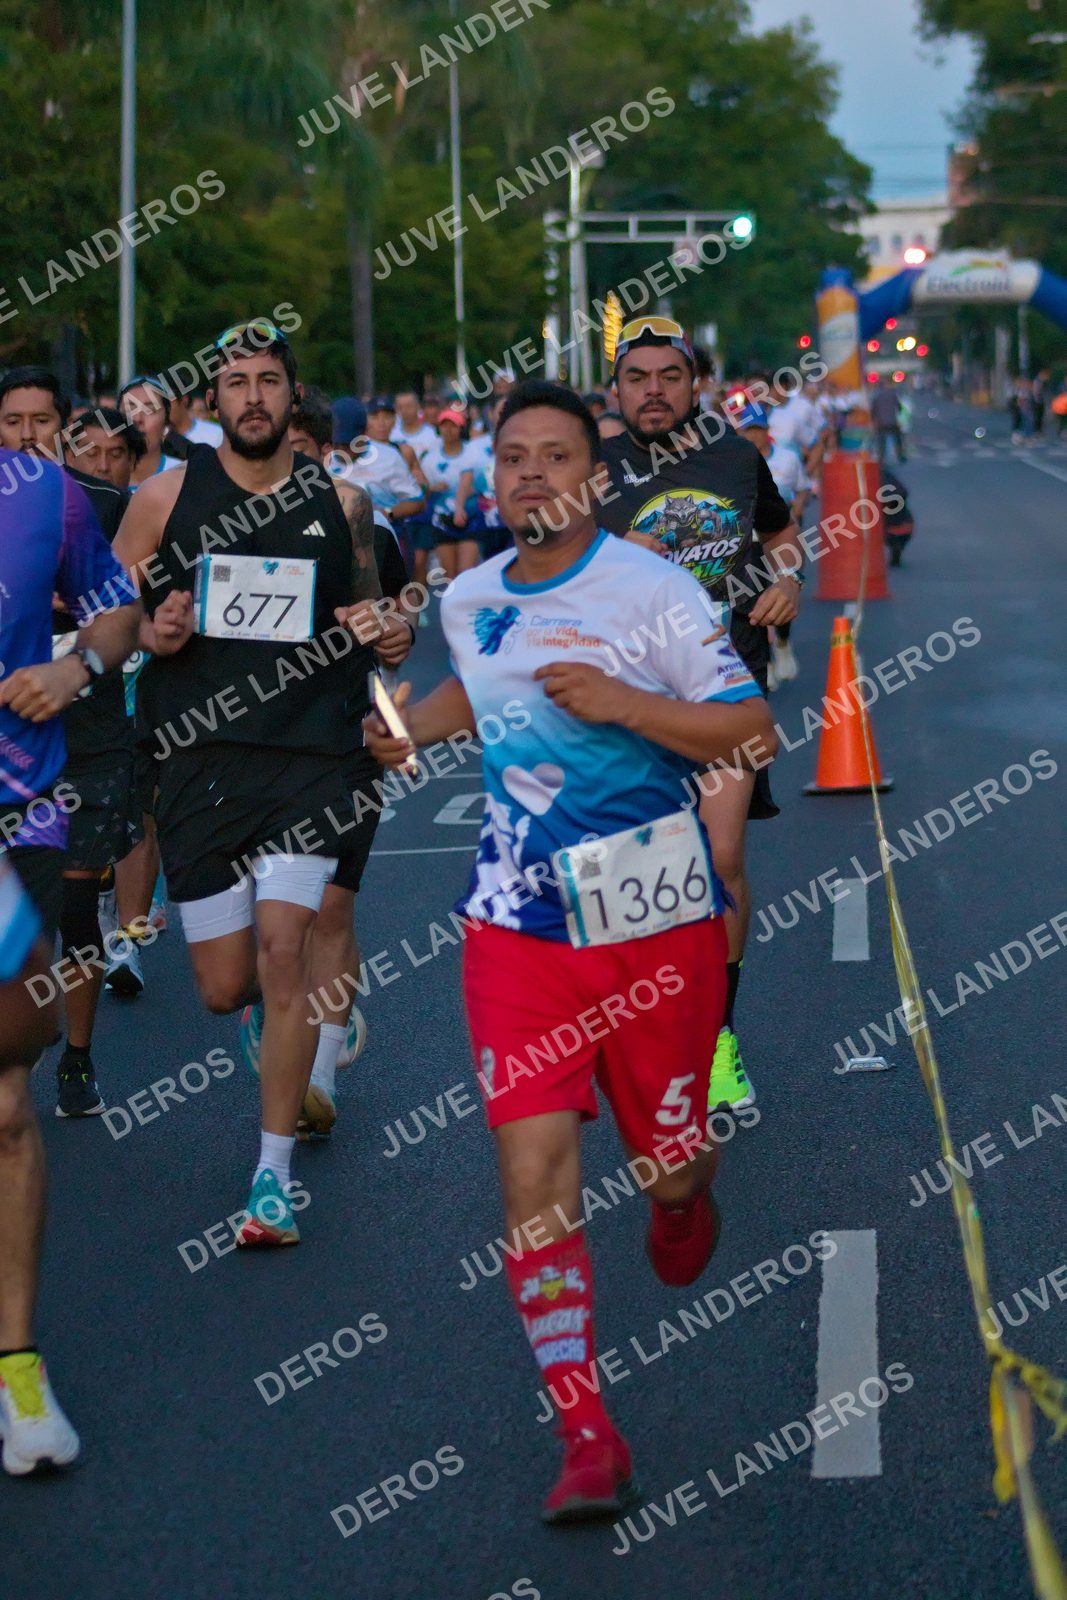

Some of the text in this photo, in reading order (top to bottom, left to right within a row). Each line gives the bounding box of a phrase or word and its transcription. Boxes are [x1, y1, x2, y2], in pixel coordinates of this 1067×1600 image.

[222, 591, 299, 630] 677
[530, 615, 582, 627] Carrera
[543, 636, 600, 649] integridad
[555, 626, 579, 637] Vida
[589, 856, 707, 930] 1366
[655, 1072, 696, 1126] 5
